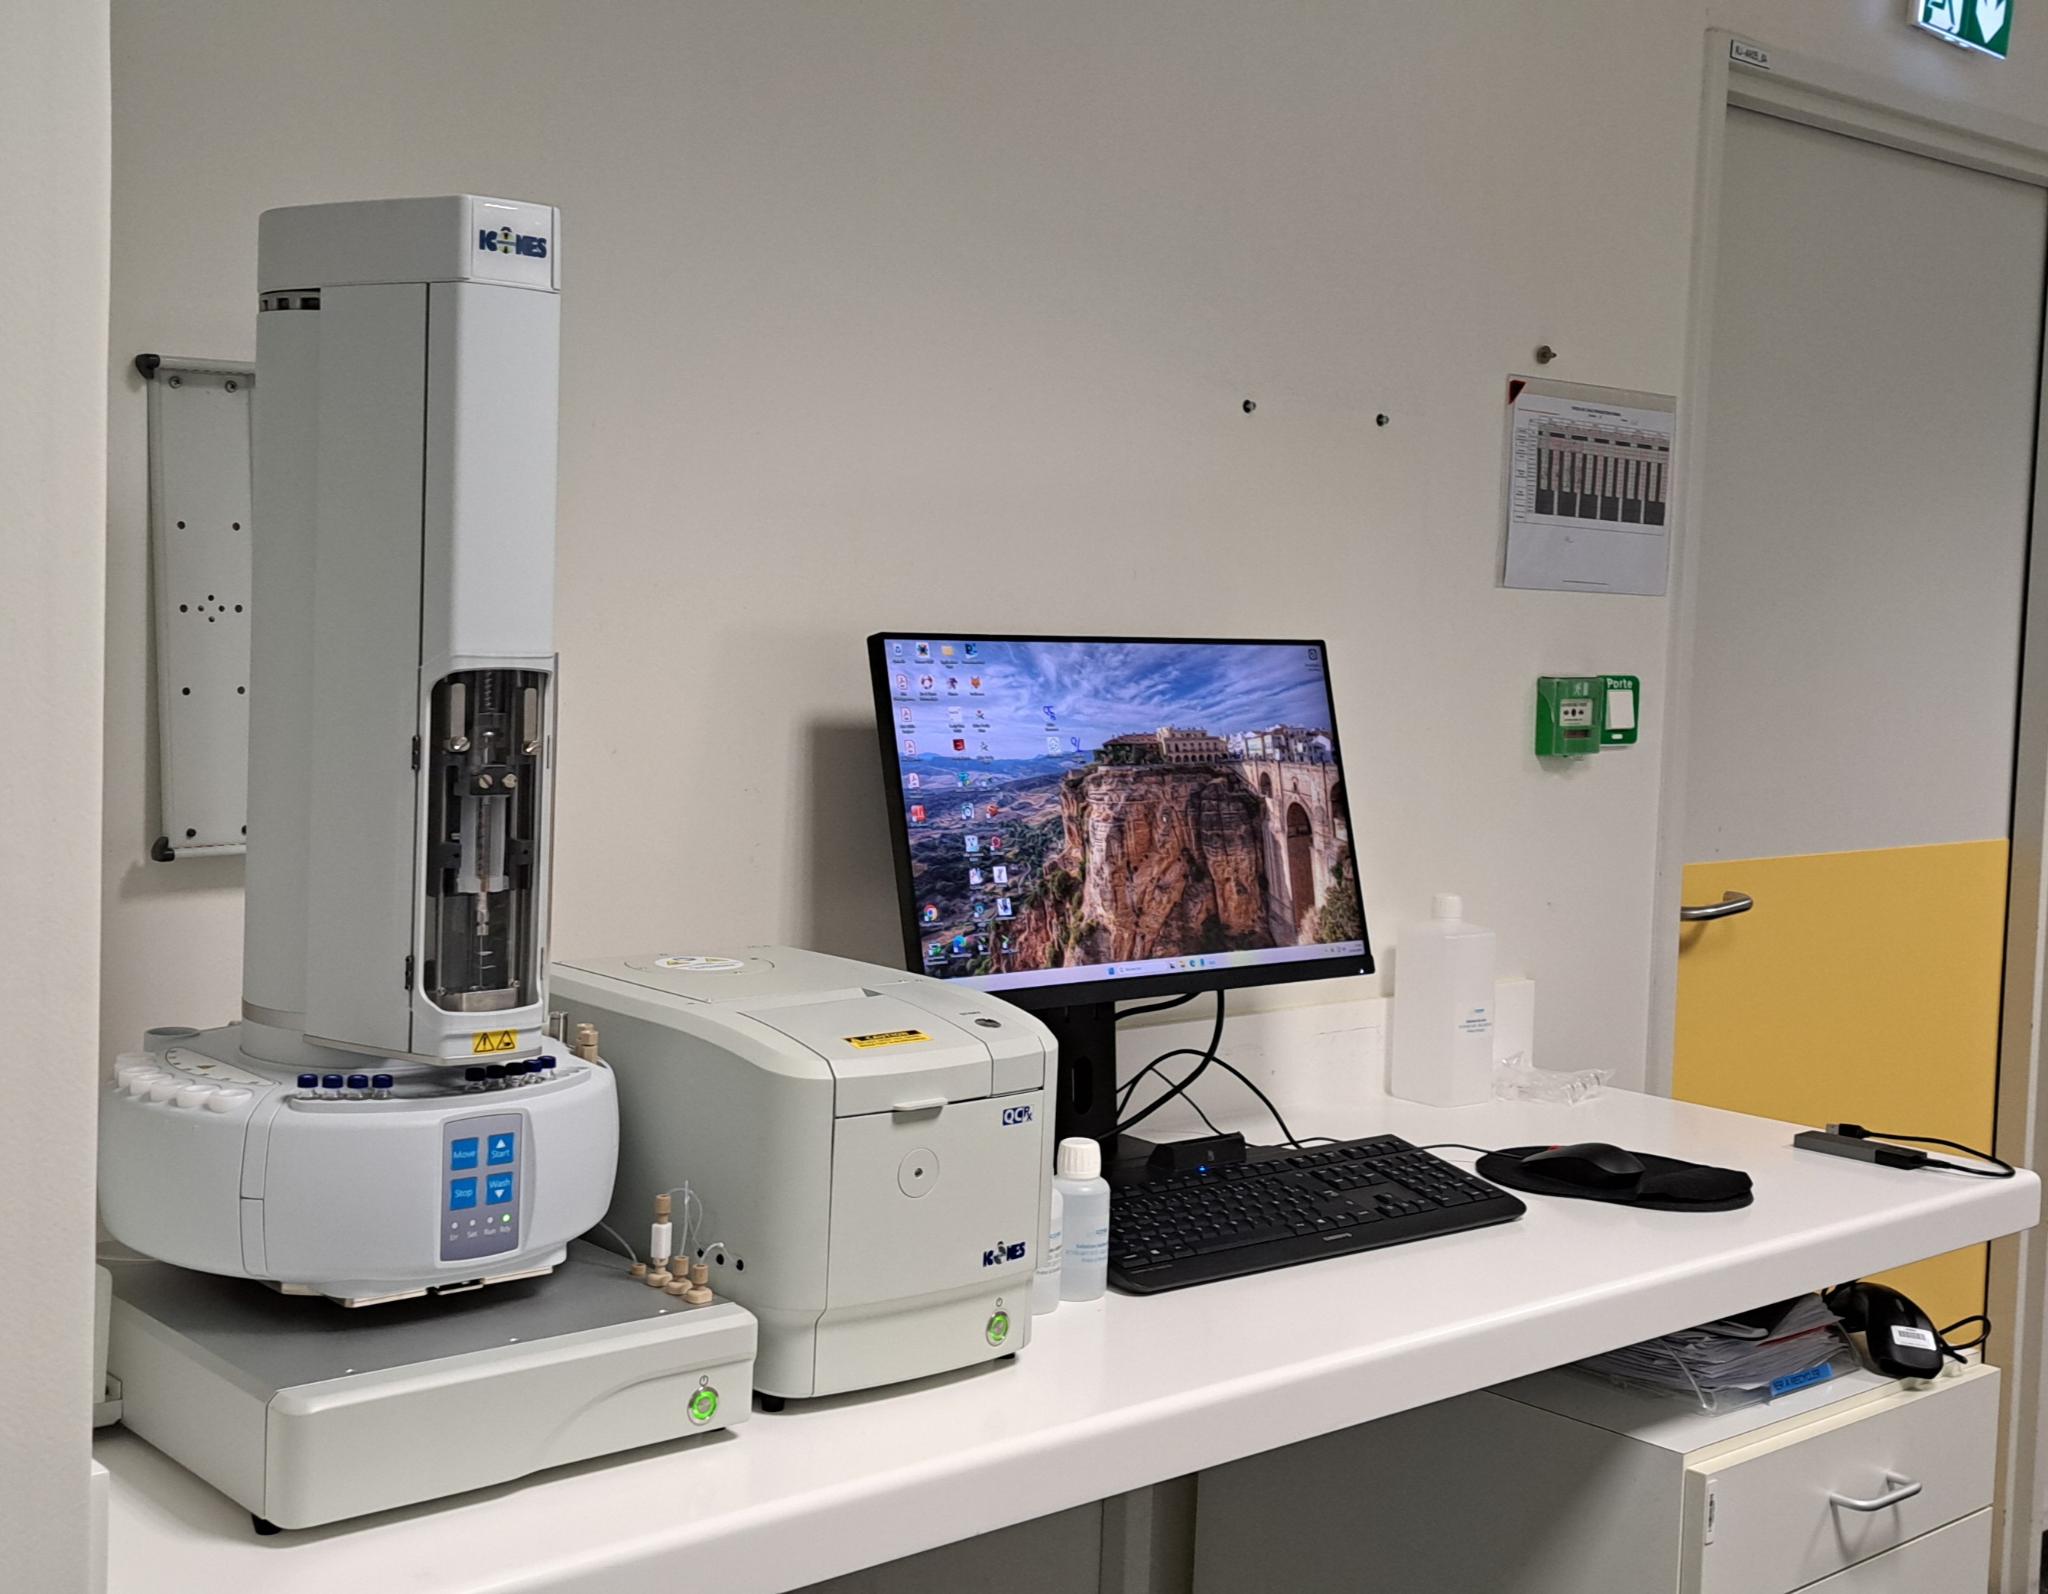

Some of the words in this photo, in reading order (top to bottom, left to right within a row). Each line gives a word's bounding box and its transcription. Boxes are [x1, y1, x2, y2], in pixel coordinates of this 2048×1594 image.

[1606, 678, 1633, 689] Porte
[453, 1150, 476, 1159] Move
[491, 1149, 511, 1159] Start
[488, 1178, 511, 1188] Wash
[454, 1189, 474, 1199] Stop
